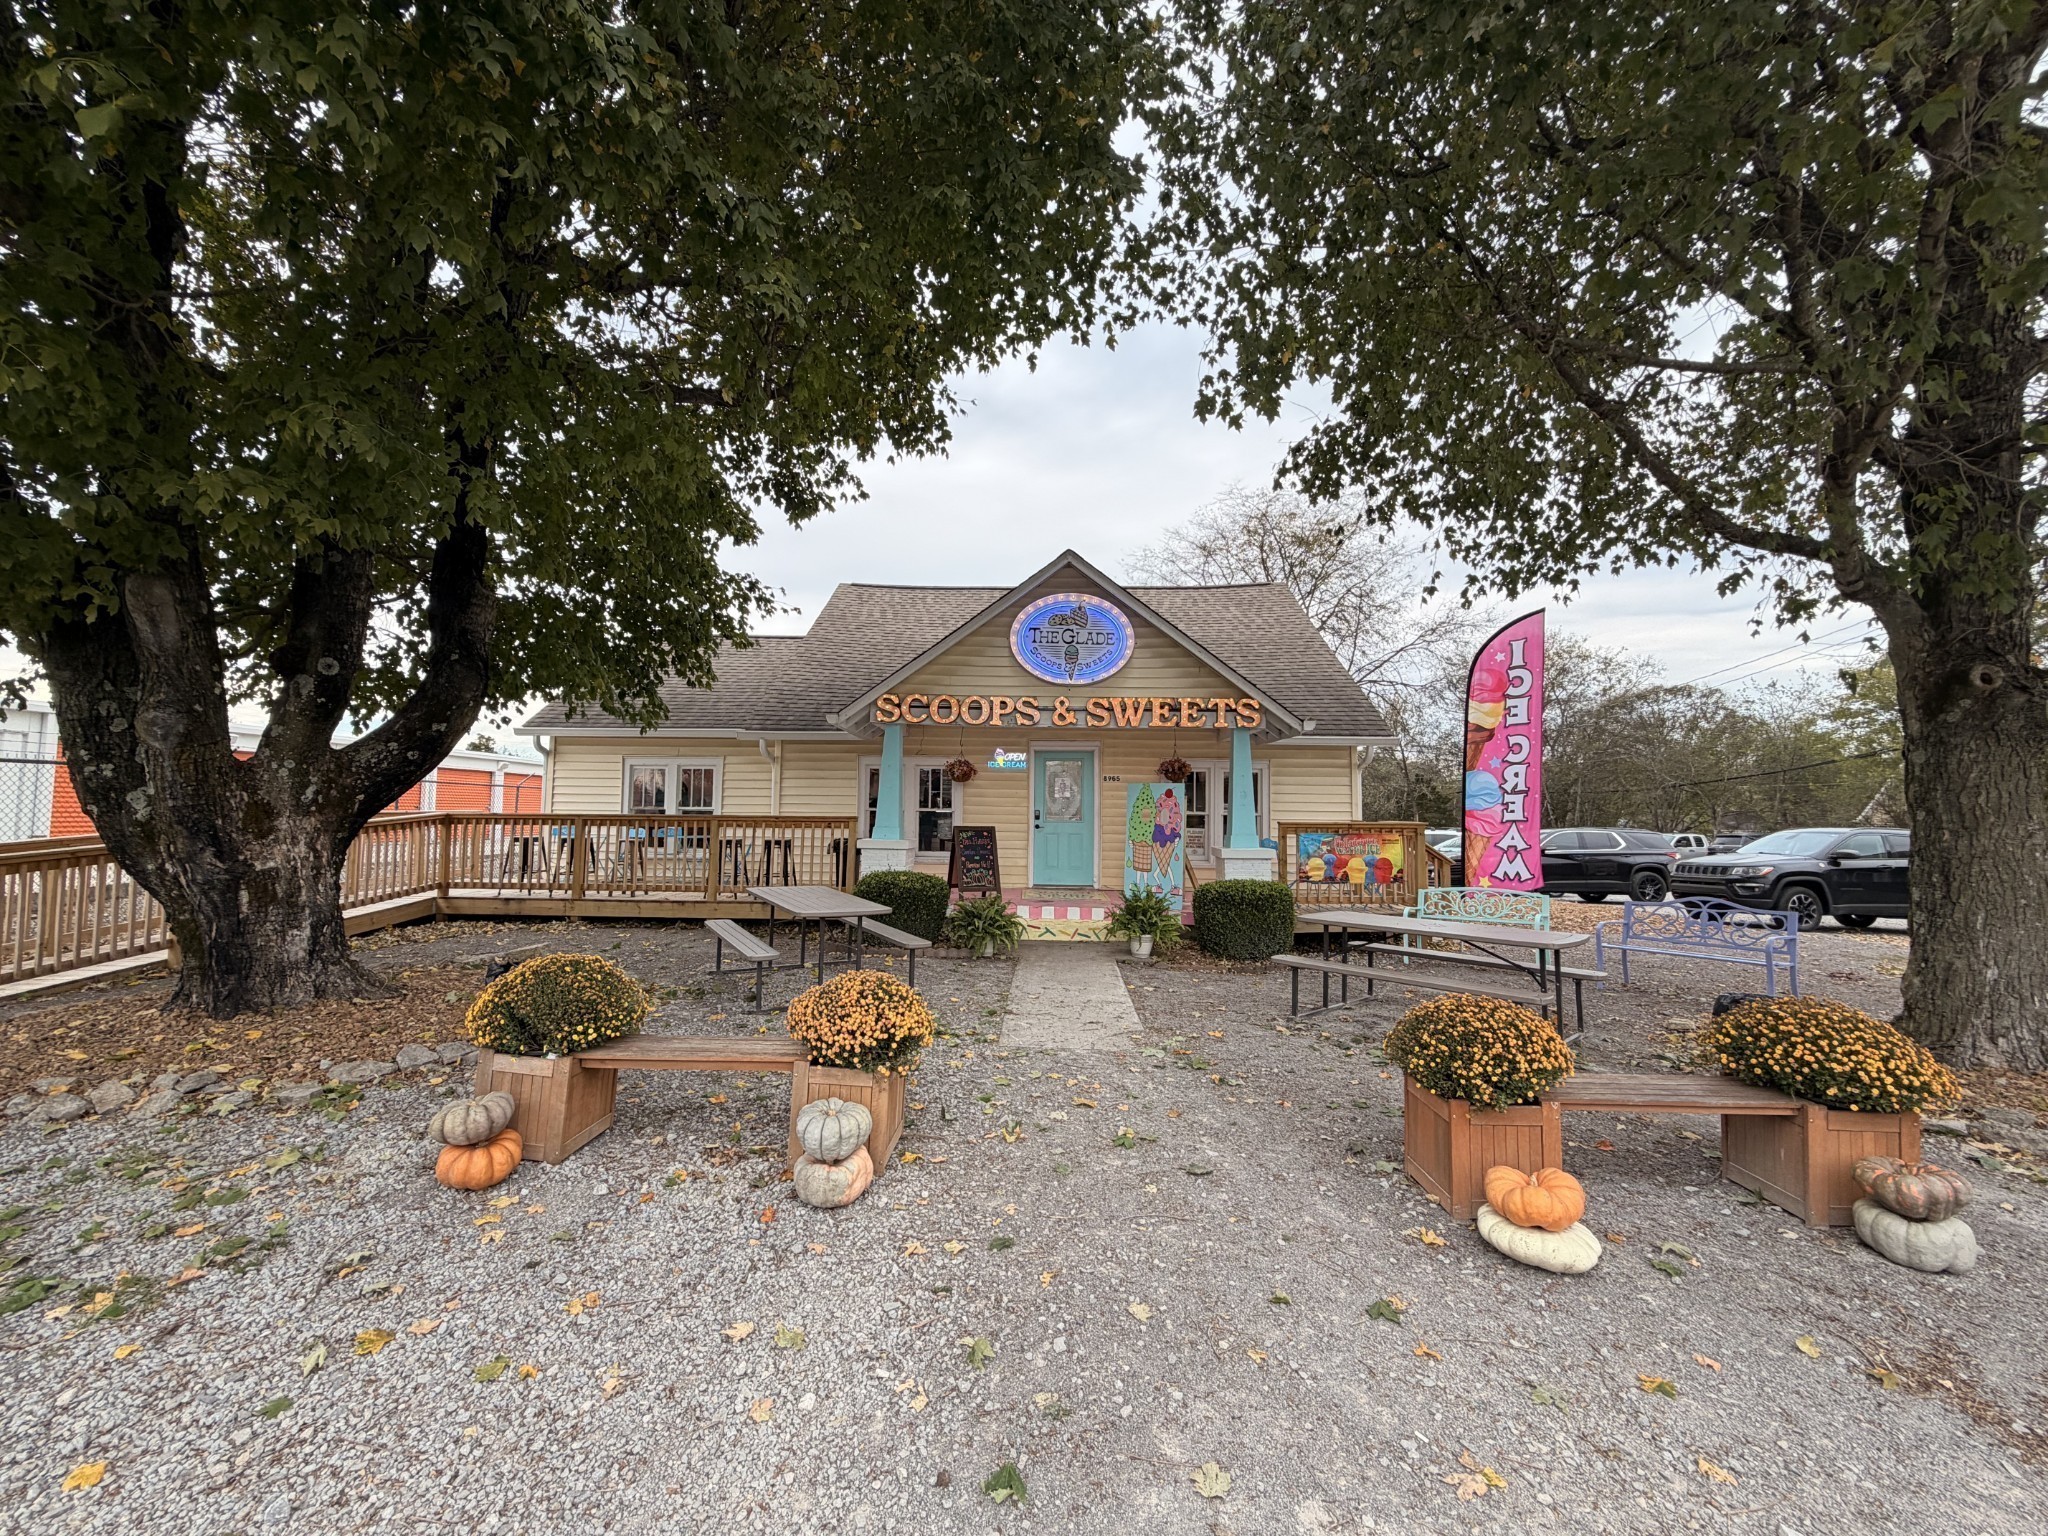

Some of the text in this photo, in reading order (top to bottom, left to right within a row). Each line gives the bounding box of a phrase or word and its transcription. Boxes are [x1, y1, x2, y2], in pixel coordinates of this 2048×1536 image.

[1028, 627, 1116, 646] THE GLADE
[1030, 646, 1063, 670] SCOOPS
[1076, 649, 1113, 671] SWEETS
[875, 693, 1262, 728] SCOOPS & SWEETS
[1004, 752, 1027, 761] OPEN
